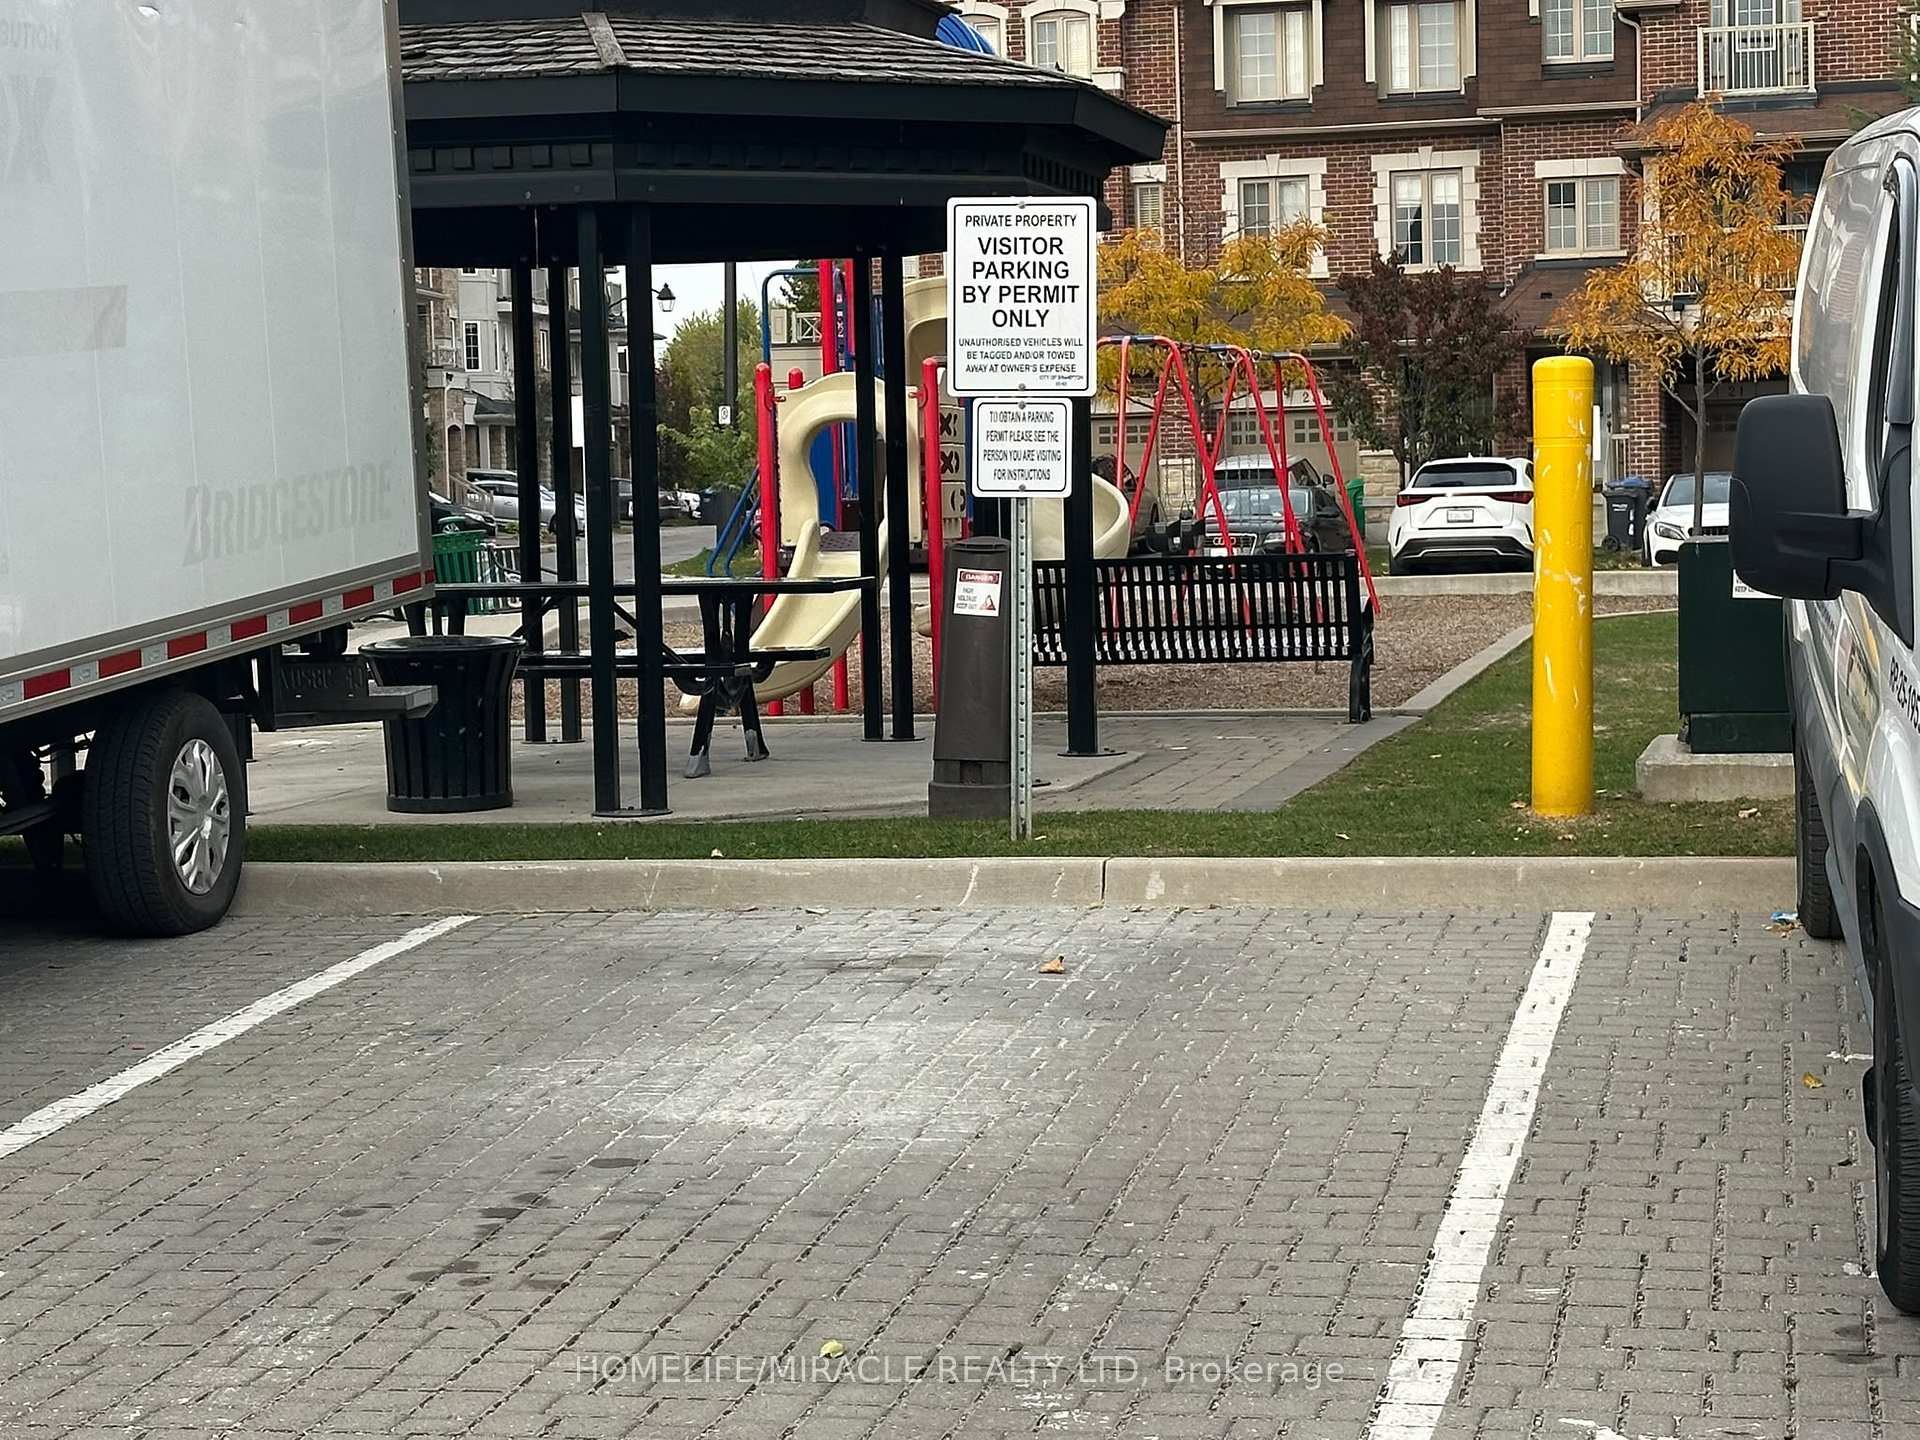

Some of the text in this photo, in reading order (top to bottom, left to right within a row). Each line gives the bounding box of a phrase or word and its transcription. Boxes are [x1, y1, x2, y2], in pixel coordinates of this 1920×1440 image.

[965, 214, 1077, 228] PRIVATE PROPERTY
[977, 236, 1065, 256] VISITOR
[972, 260, 1070, 280] PARKING
[962, 284, 1081, 304] BY PERMIT
[991, 308, 1050, 328] ONLY
[958, 337, 1084, 347] UNAUTHORISED VEHICLES WILL
[966, 350, 1076, 360] BE TAGGED AND/OR TOWED
[965, 363, 1077, 373] AWAY AT OWNER'S EXPENSE
[989, 410, 1055, 424] TO OBTAIN A PARKING
[985, 430, 1060, 443] PERMIT PLEASE SEE THE
[982, 448, 1062, 462] PERSON YOU ARE VISITING
[993, 468, 1051, 481] FOR INSTRUCTIONS
[1889, 655, 1920, 735] RP-25-195
